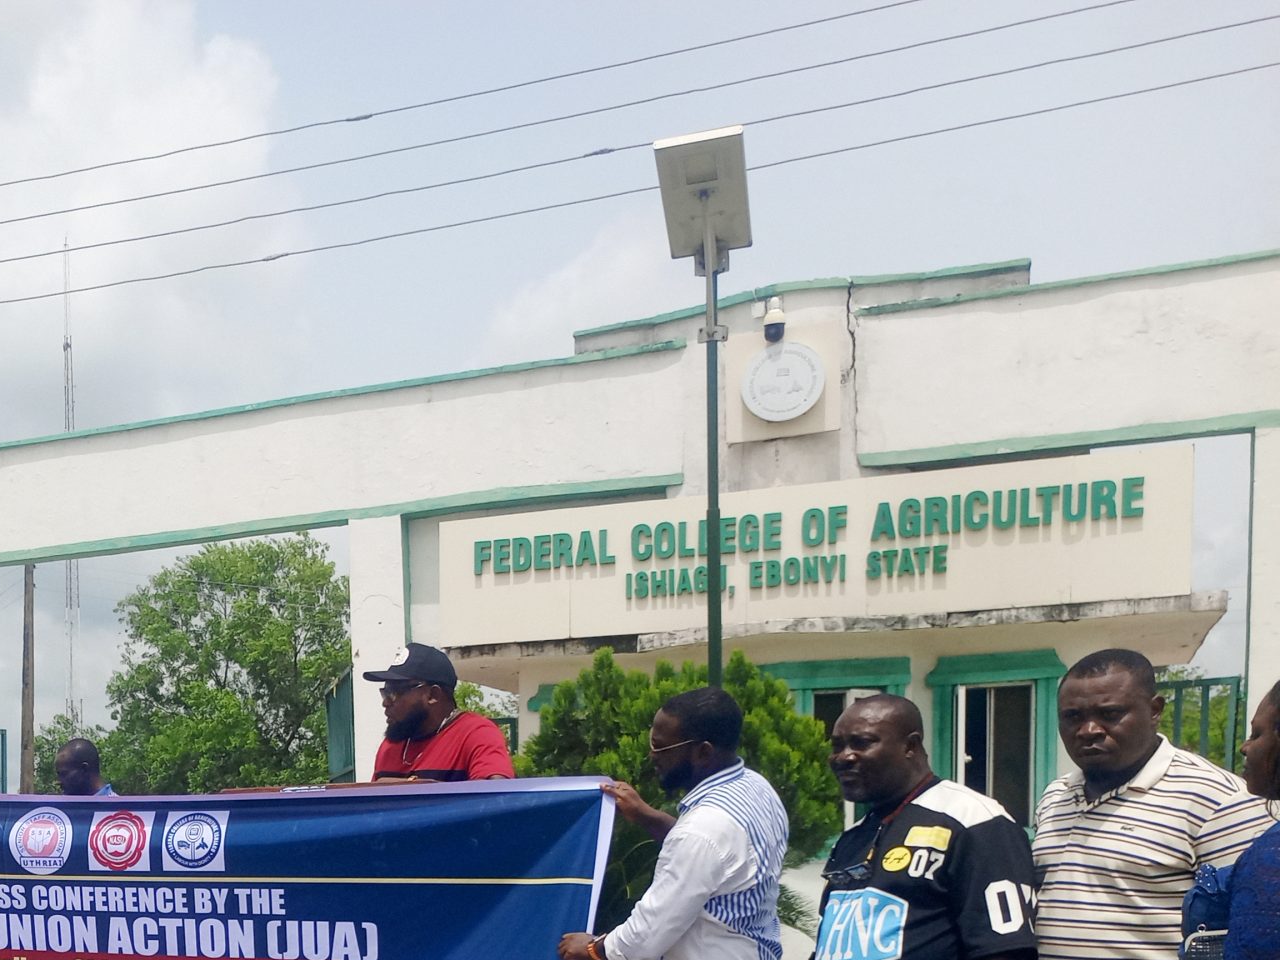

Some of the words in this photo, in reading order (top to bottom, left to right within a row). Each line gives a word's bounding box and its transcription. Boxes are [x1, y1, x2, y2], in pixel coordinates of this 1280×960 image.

[474, 529, 616, 576] FEDERAL
[631, 512, 782, 561] COLLEGE
[802, 505, 847, 547] OF
[870, 476, 1145, 541] AGRICULTURE
[749, 554, 846, 588] EBONYI
[866, 544, 948, 580] STATE
[907, 849, 945, 880] 07
[32, 885, 188, 914] CONFERENCE
[194, 888, 227, 914] BY
[234, 888, 286, 915] THE
[107, 916, 256, 959] ACTION
